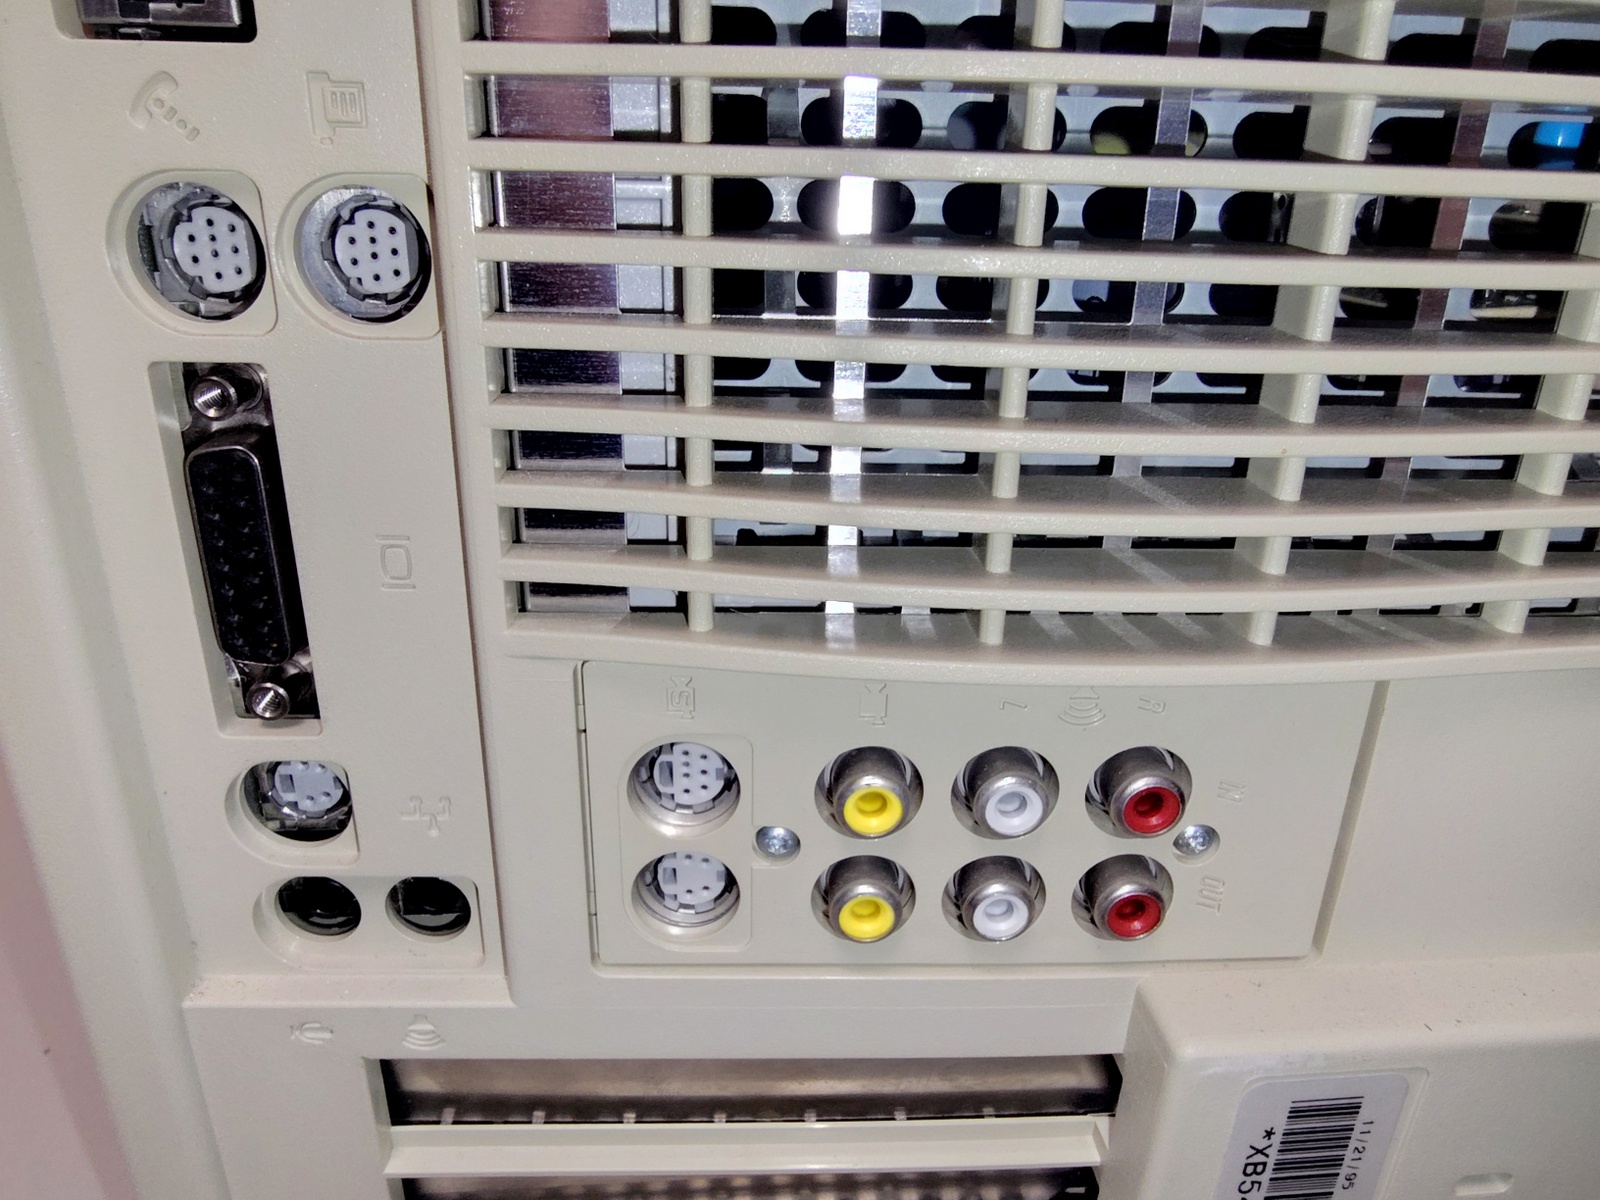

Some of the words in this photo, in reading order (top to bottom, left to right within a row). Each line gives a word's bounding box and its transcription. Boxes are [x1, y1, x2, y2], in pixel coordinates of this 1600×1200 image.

[1138, 697, 1166, 714] R
[1217, 781, 1247, 803] IN
[1195, 876, 1226, 915] OUT
[1237, 1126, 1276, 1200] XB5
[1341, 1120, 1375, 1191] 11/21/95
